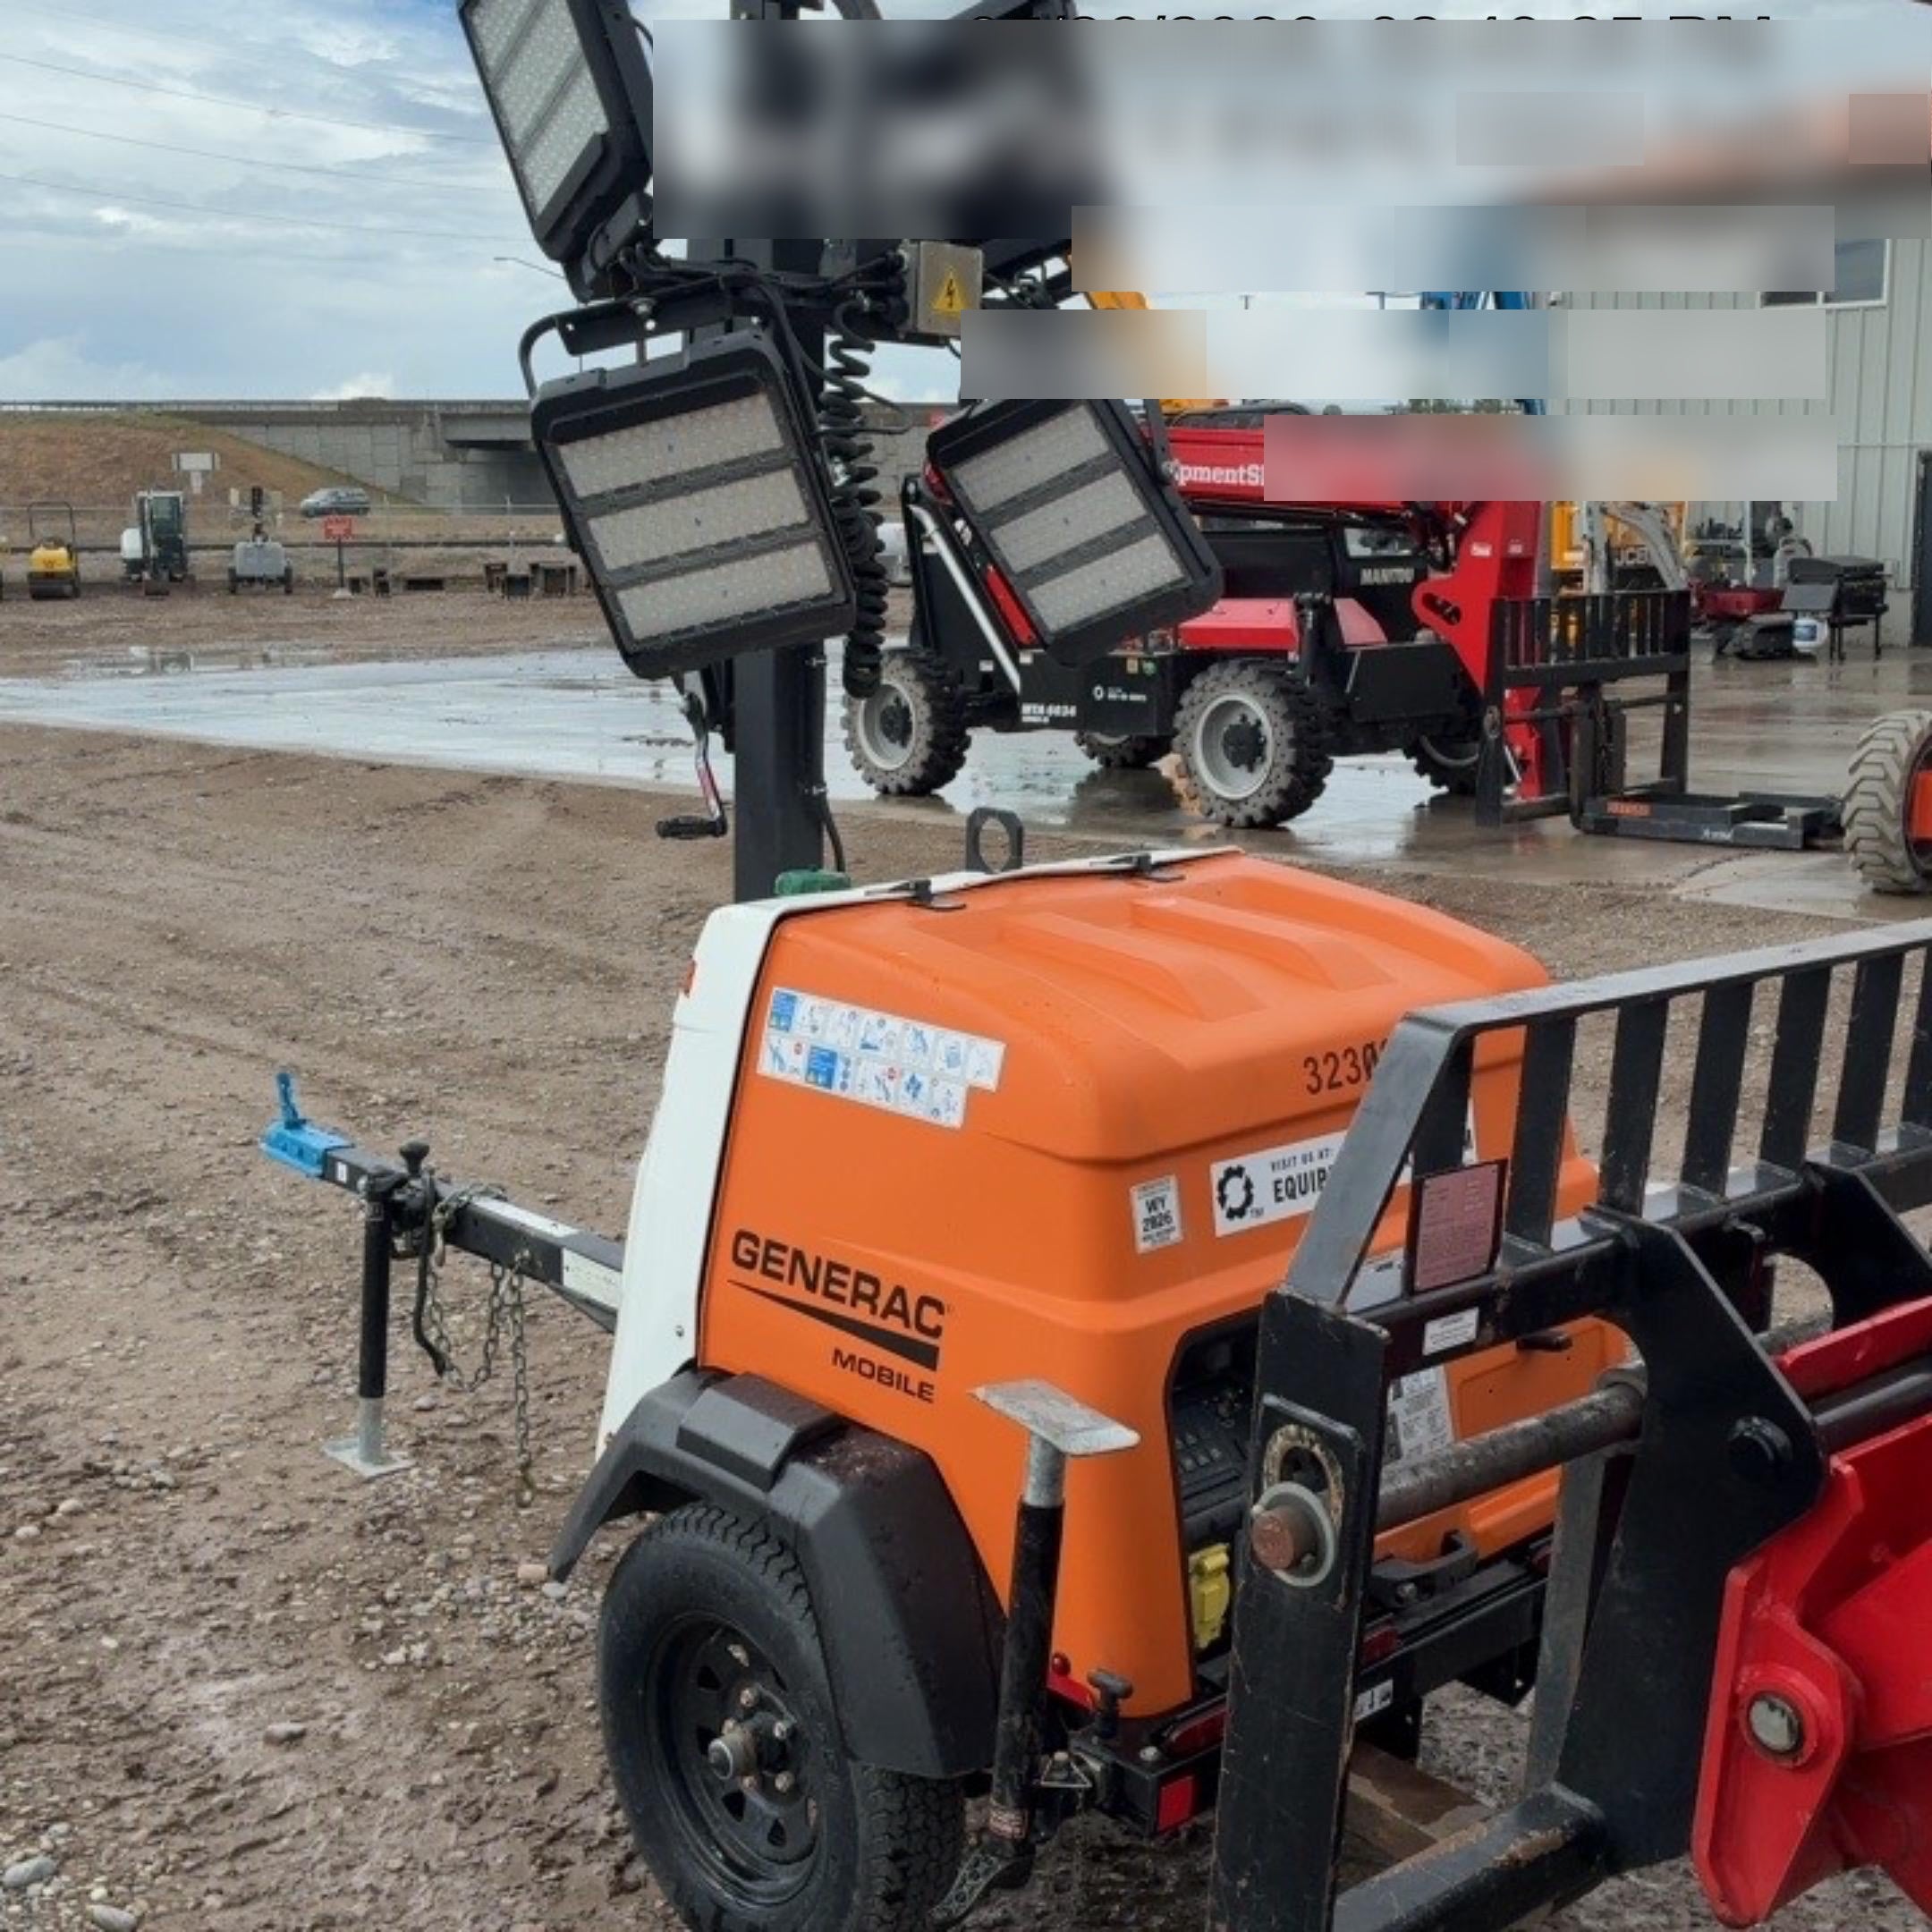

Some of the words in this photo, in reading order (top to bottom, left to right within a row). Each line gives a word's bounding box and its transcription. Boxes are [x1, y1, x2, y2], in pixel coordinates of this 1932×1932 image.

[1304, 1038, 1388, 1095] 3230
[1271, 1157, 1297, 1173] VISIT
[1301, 1151, 1314, 1165] US
[732, 1229, 945, 1340] GENERAC
[831, 1347, 935, 1404] MOBILE
